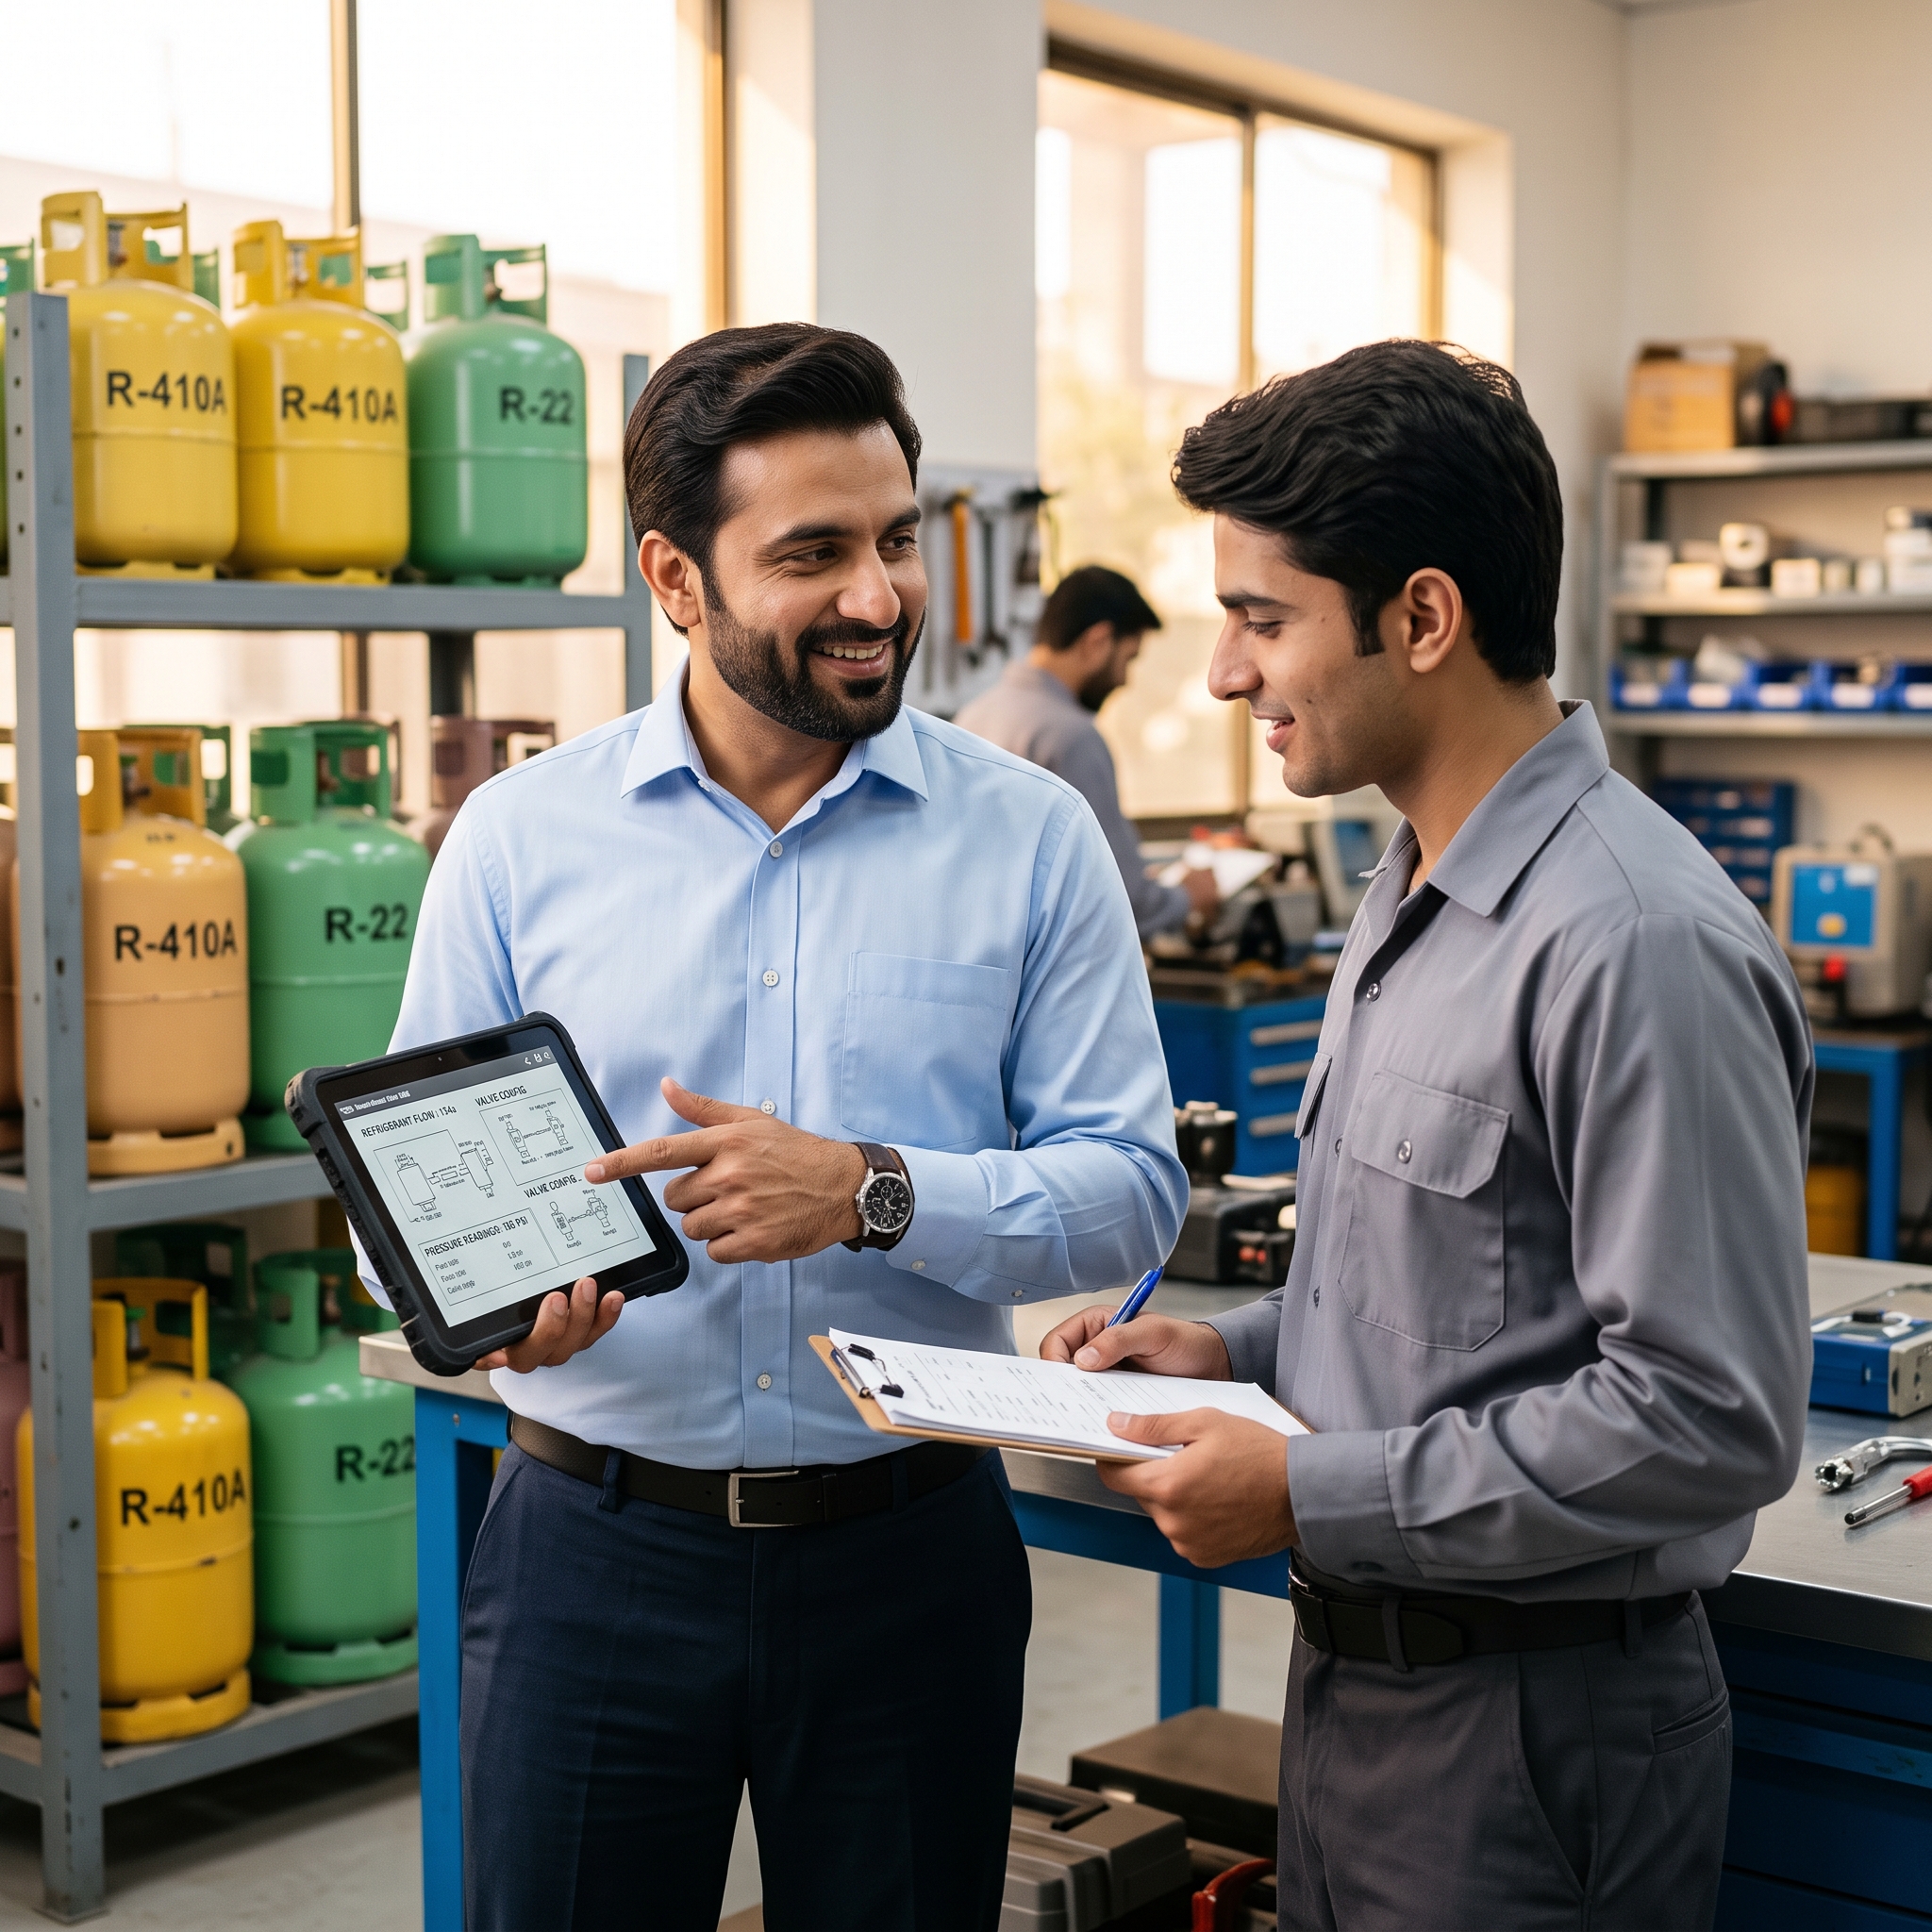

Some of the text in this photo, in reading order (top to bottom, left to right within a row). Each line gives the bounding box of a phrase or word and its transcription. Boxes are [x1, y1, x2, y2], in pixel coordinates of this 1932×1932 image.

[107, 370, 227, 414] R-410A
[281, 385, 399, 424] R-410A
[500, 386, 574, 425] R-22
[114, 920, 238, 961] R-410A
[325, 903, 409, 943] R-22
[413, 1109, 435, 1124] FLOW
[475, 1092, 500, 1107] VALVE
[425, 1237, 463, 1257] PRESSURE
[335, 1434, 416, 1483] R-22
[120, 1468, 246, 1526] R-410A
